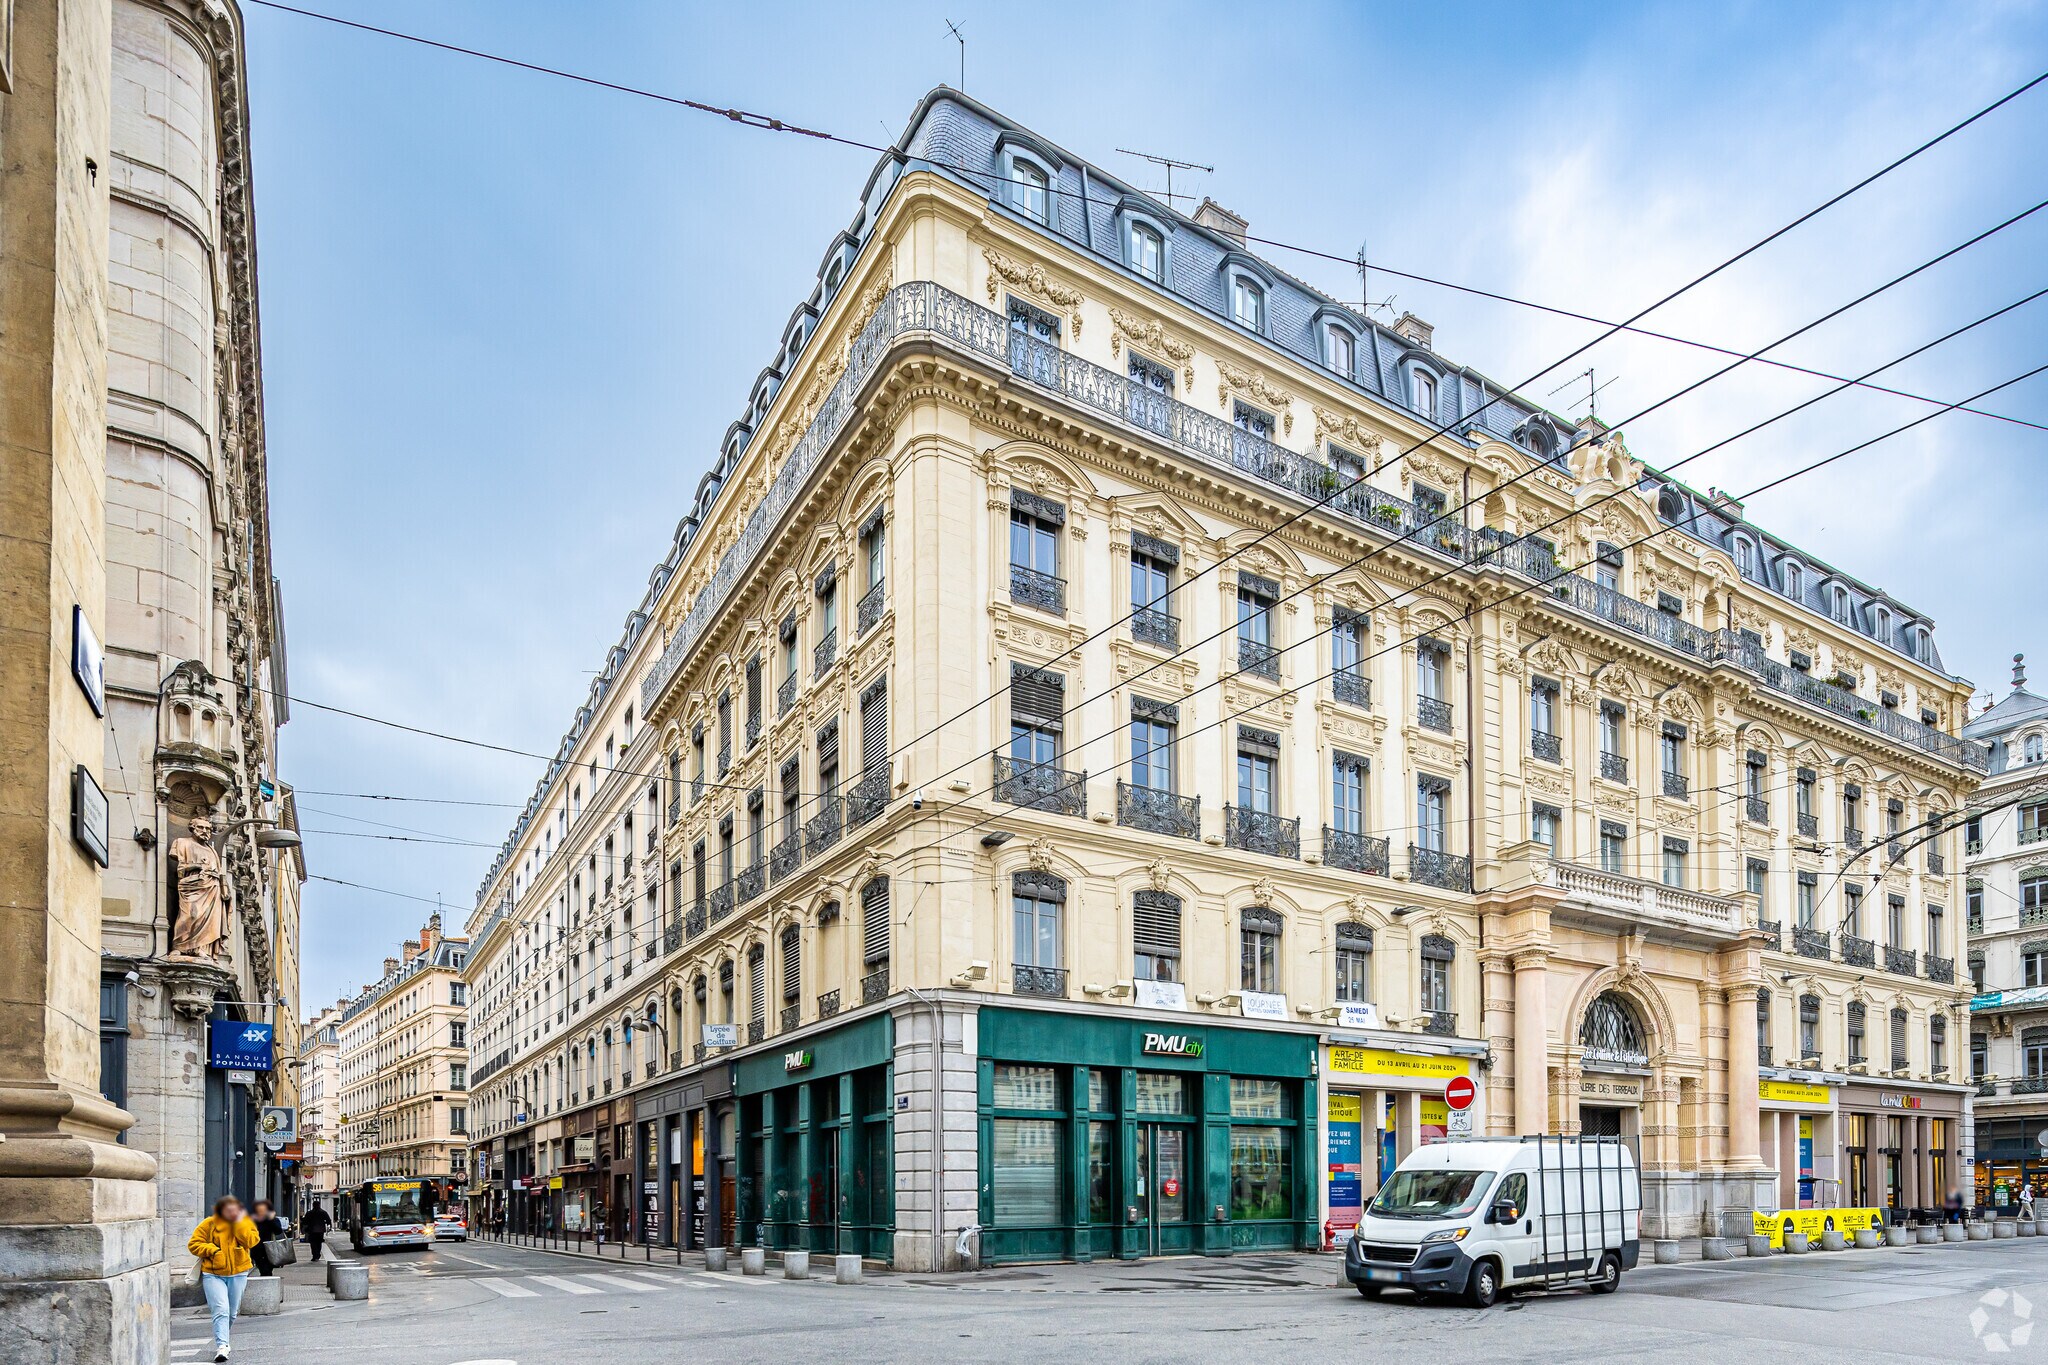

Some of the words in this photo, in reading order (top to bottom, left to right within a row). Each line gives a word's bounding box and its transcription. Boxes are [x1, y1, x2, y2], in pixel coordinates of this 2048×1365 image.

[1345, 1007, 1369, 1015] SAMEDI
[709, 1025, 730, 1034] Lycée
[706, 1038, 736, 1046] Coiffure
[1144, 1033, 1187, 1053] PMU
[1185, 1041, 1204, 1057] city
[216, 1053, 266, 1062] BANQUE
[784, 1050, 803, 1070] PMU
[215, 1060, 267, 1068] POPULAIRE
[1334, 1060, 1363, 1070] FAMILLE
[1579, 1082, 1596, 1092] ALERIE
[1598, 1083, 1610, 1094] DES
[1612, 1084, 1638, 1095] TERREAUX
[373, 1183, 382, 1192] S6
